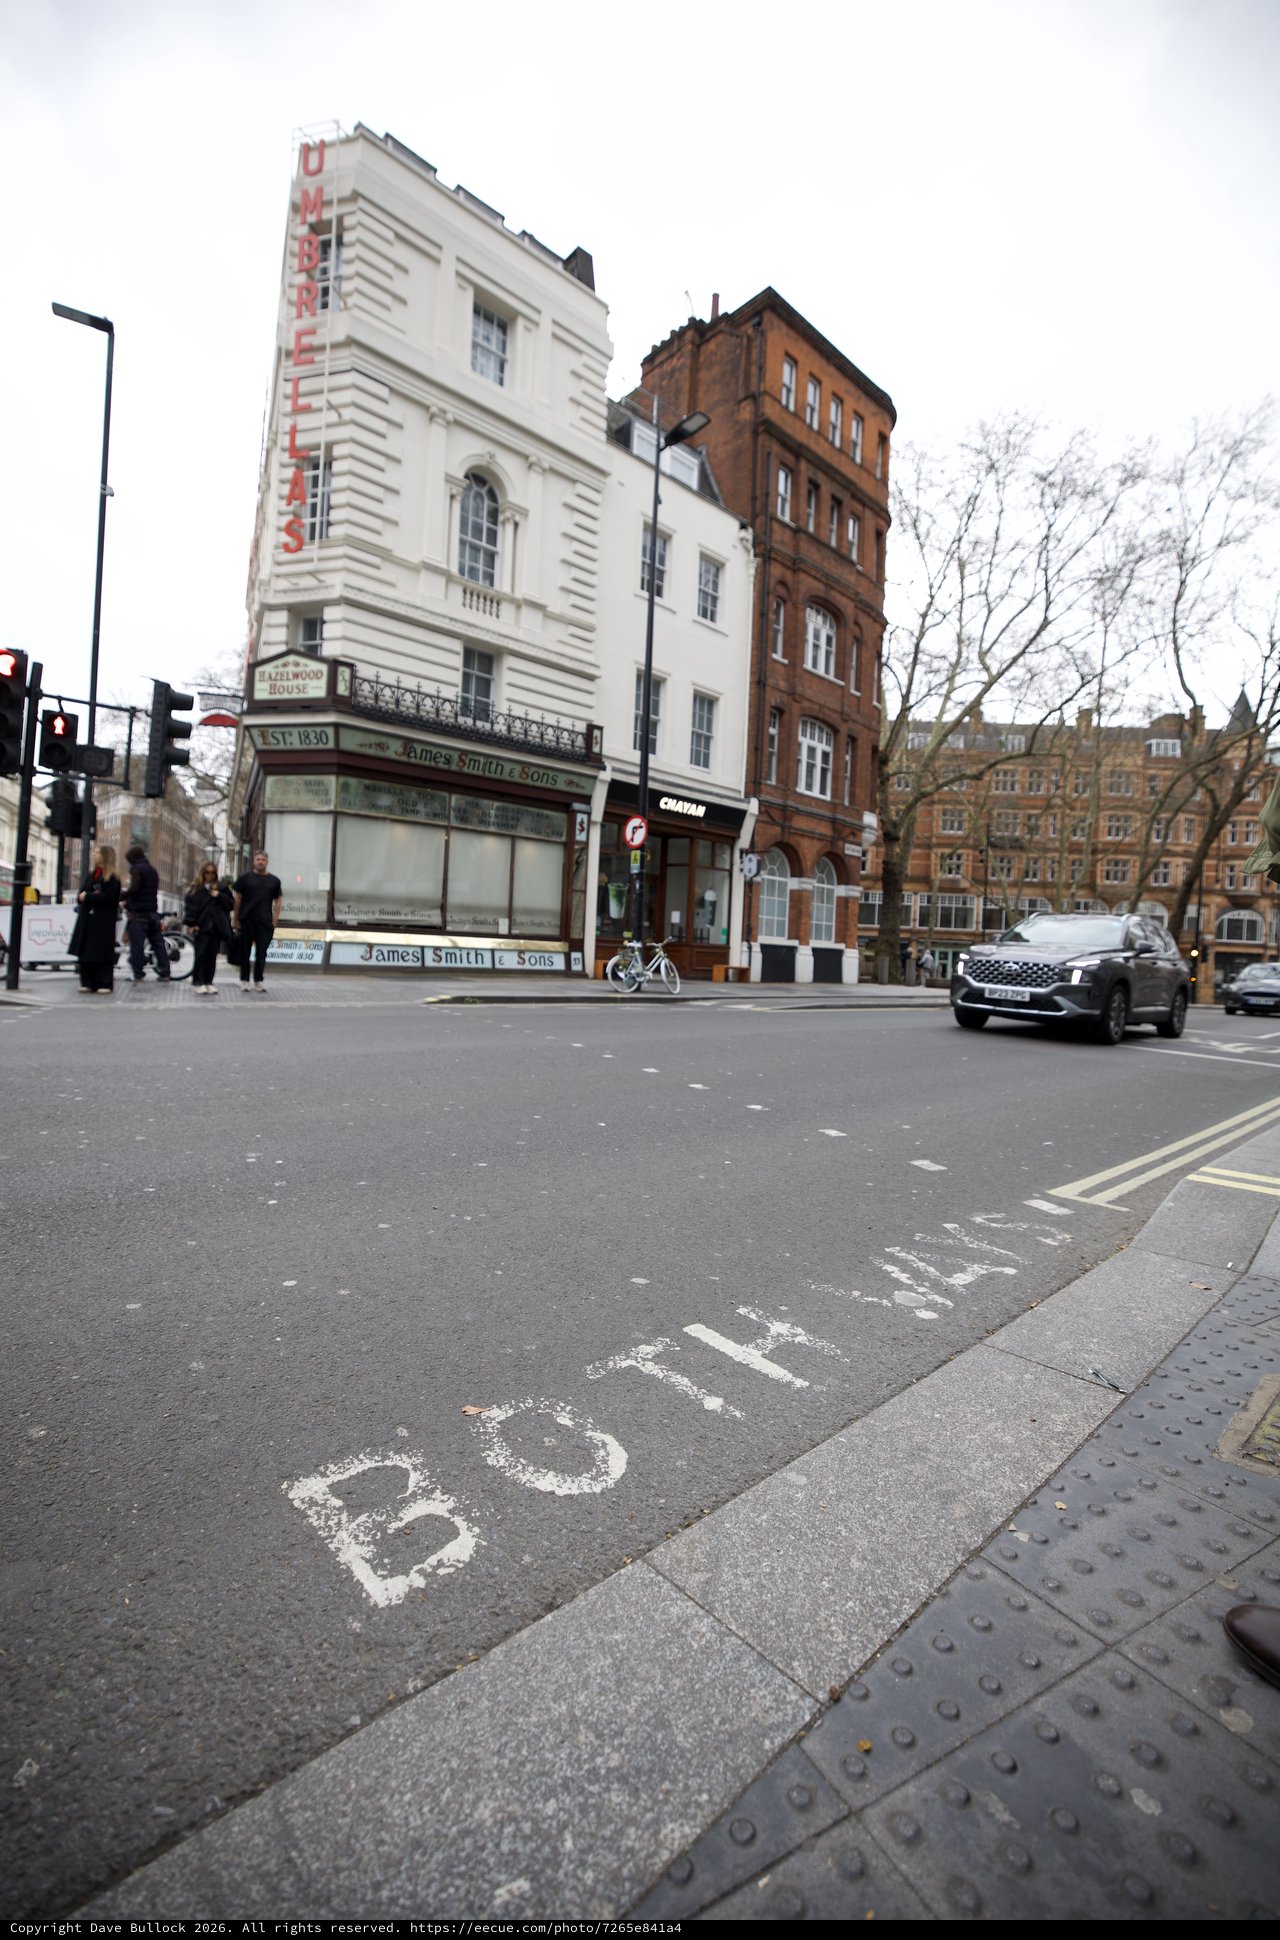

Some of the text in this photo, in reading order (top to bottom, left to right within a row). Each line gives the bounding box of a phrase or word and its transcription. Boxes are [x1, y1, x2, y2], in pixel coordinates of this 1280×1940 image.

[282, 139, 325, 554] UMBRELLAS
[258, 669, 324, 682] HAZELWOOD
[268, 683, 309, 695] HOUSE
[297, 729, 329, 746] 1830
[394, 740, 451, 766] James
[456, 751, 504, 776] Smith
[519, 765, 558, 786] Sons
[659, 796, 706, 817] CHAYAN
[360, 944, 421, 963] James
[432, 947, 484, 965] Smith
[517, 951, 554, 967] Sons
[281, 1304, 848, 1609] BOTH
